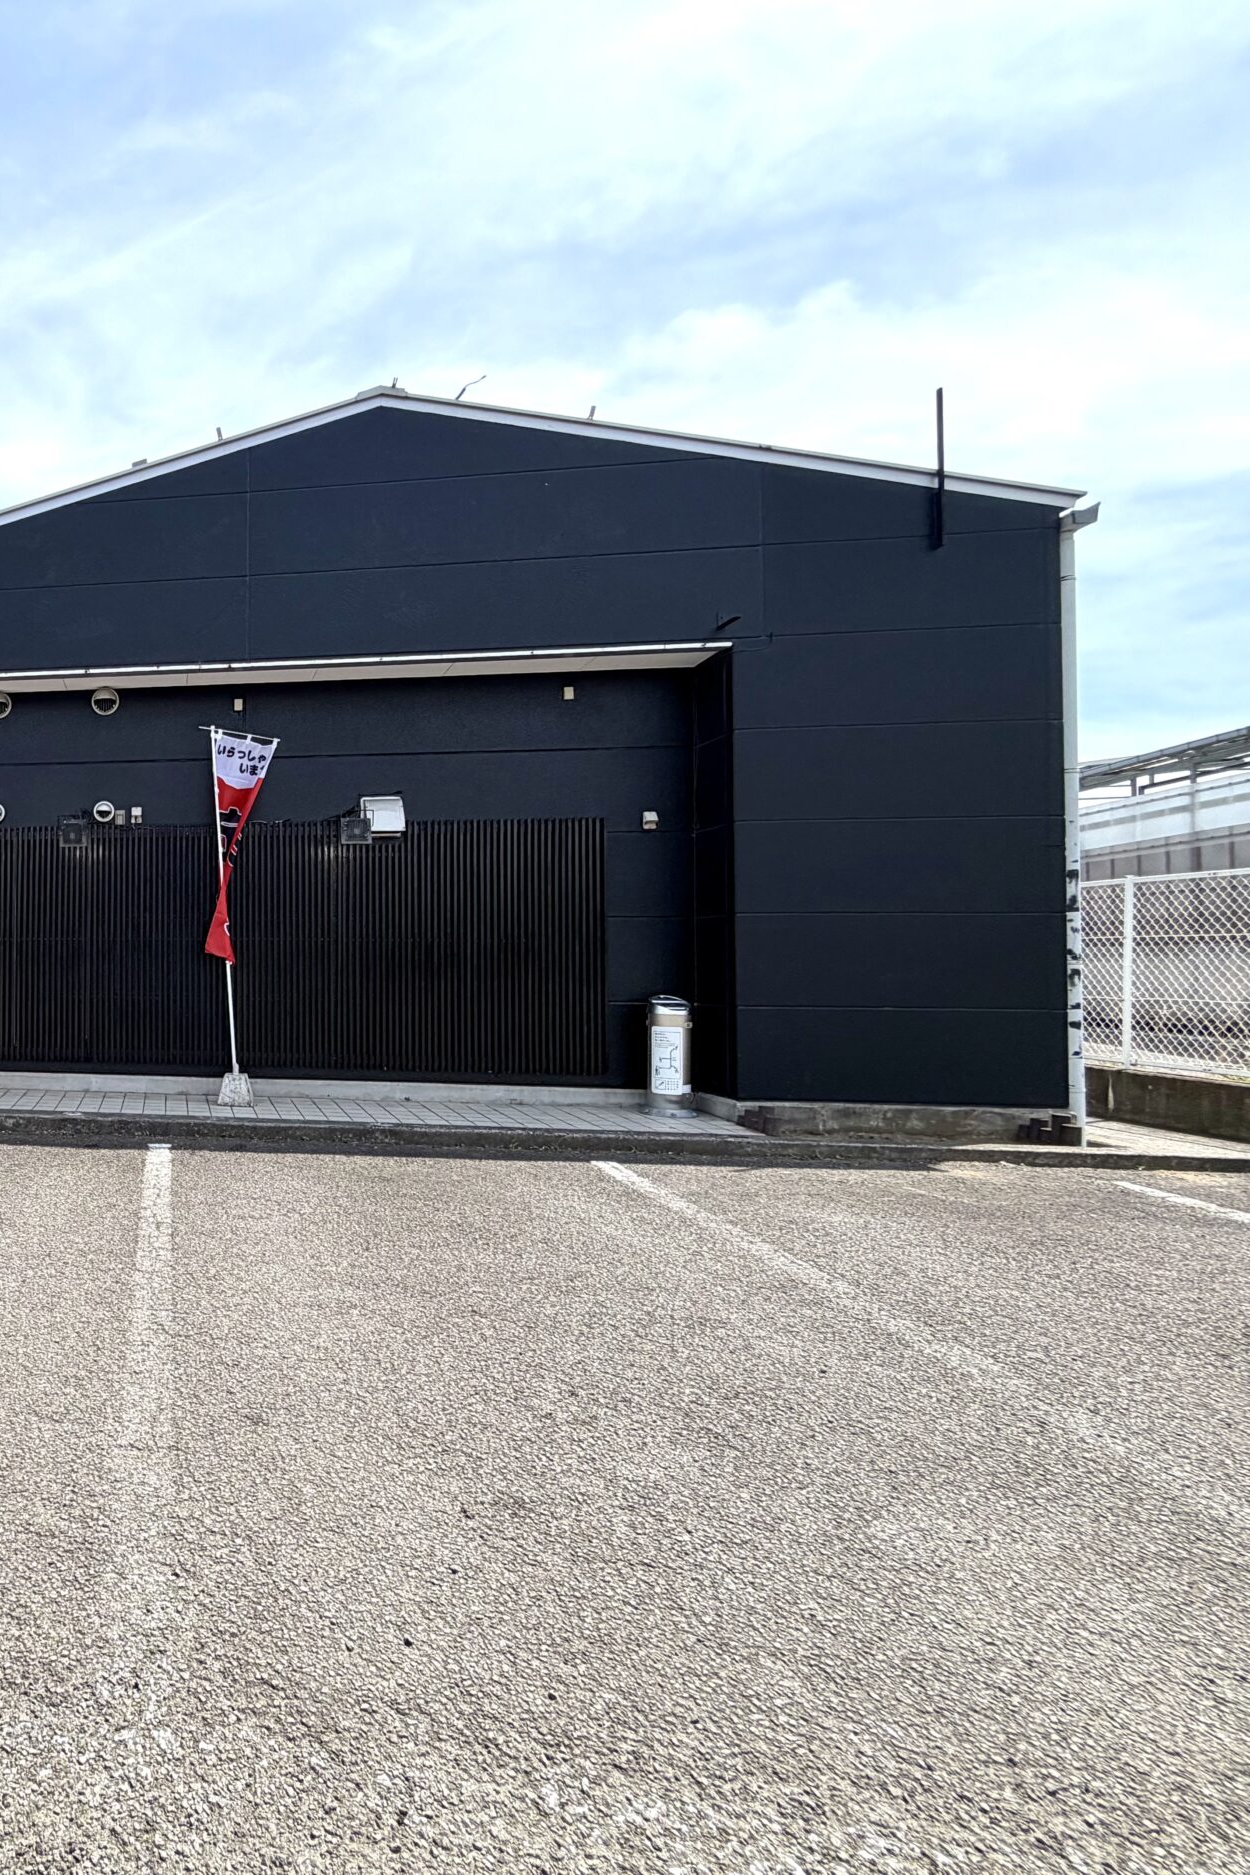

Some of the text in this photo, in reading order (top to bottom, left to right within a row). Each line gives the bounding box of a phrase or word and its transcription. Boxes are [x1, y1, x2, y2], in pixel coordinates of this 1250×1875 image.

[217, 744, 267, 763] いらっしゃ
